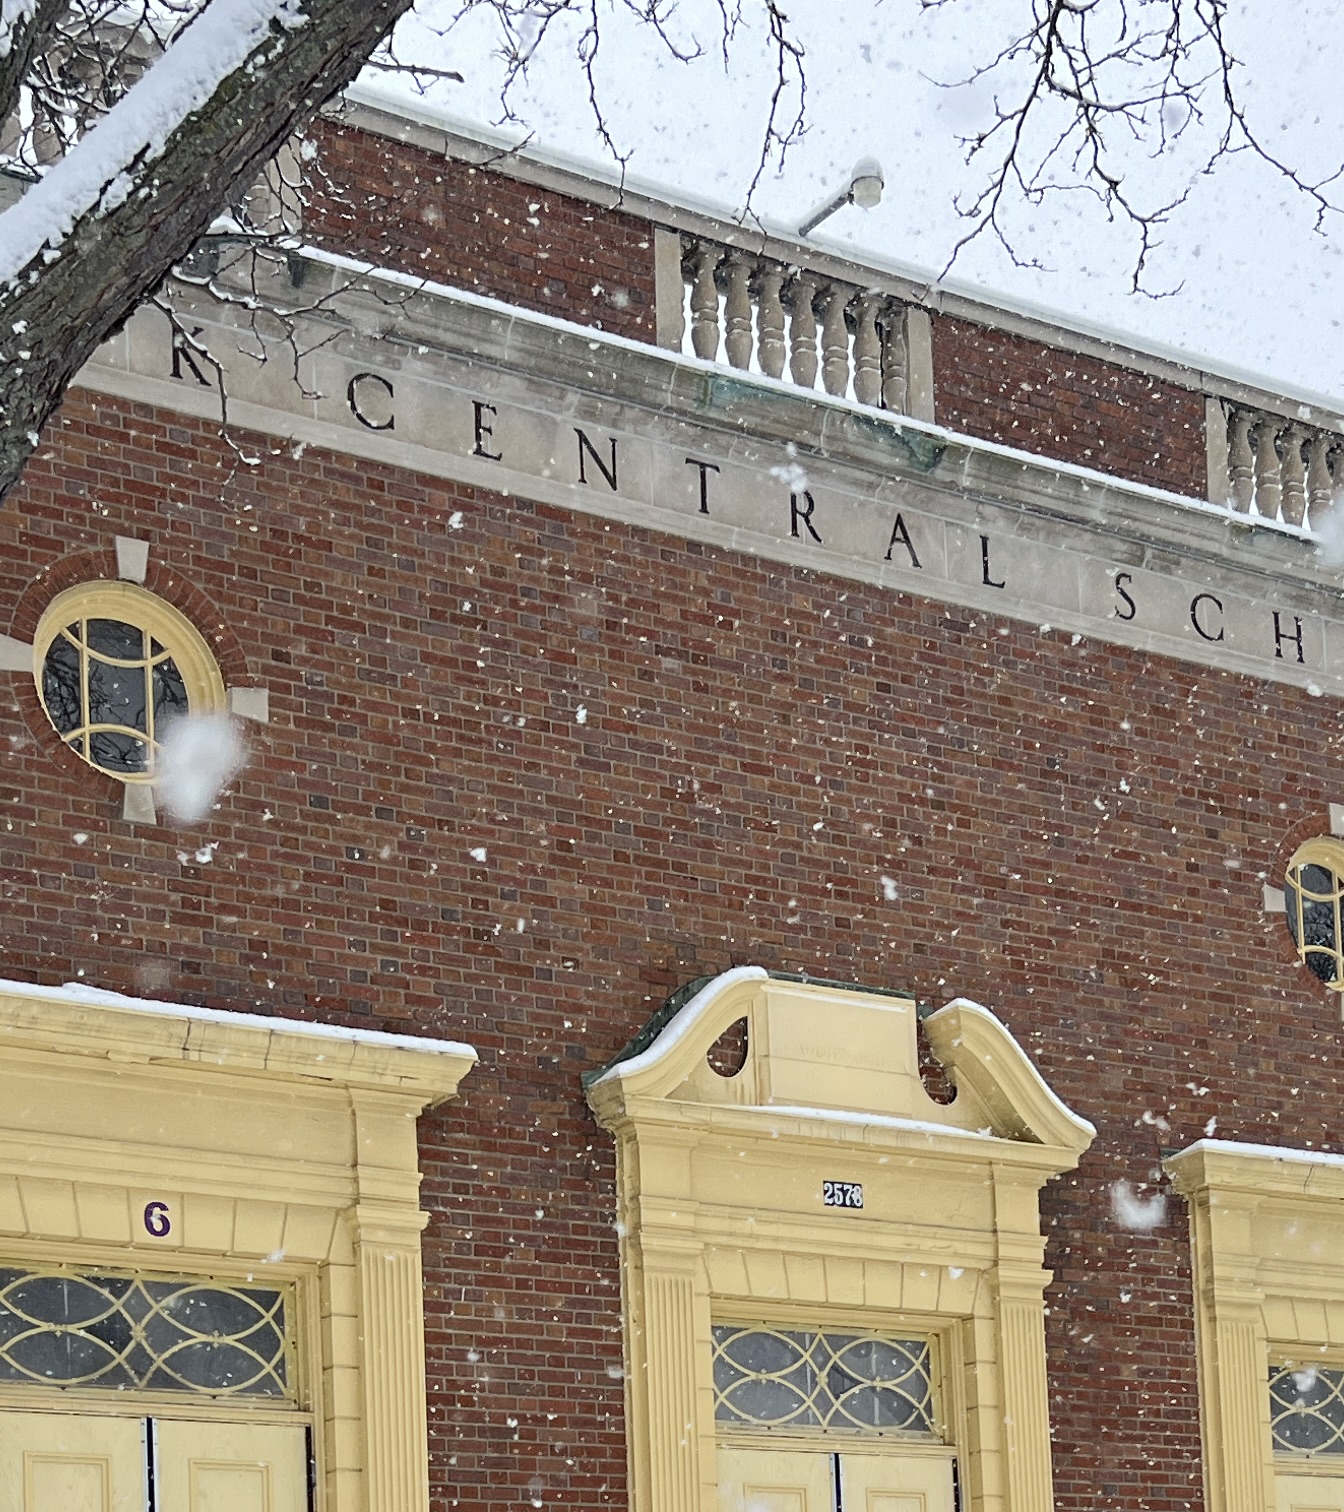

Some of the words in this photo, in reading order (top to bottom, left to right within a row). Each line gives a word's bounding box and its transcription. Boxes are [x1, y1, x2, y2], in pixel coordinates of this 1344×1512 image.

[347, 372, 1005, 589] CENTRAL
[823, 1182, 863, 1207] 2578
[144, 1201, 170, 1237] 6
